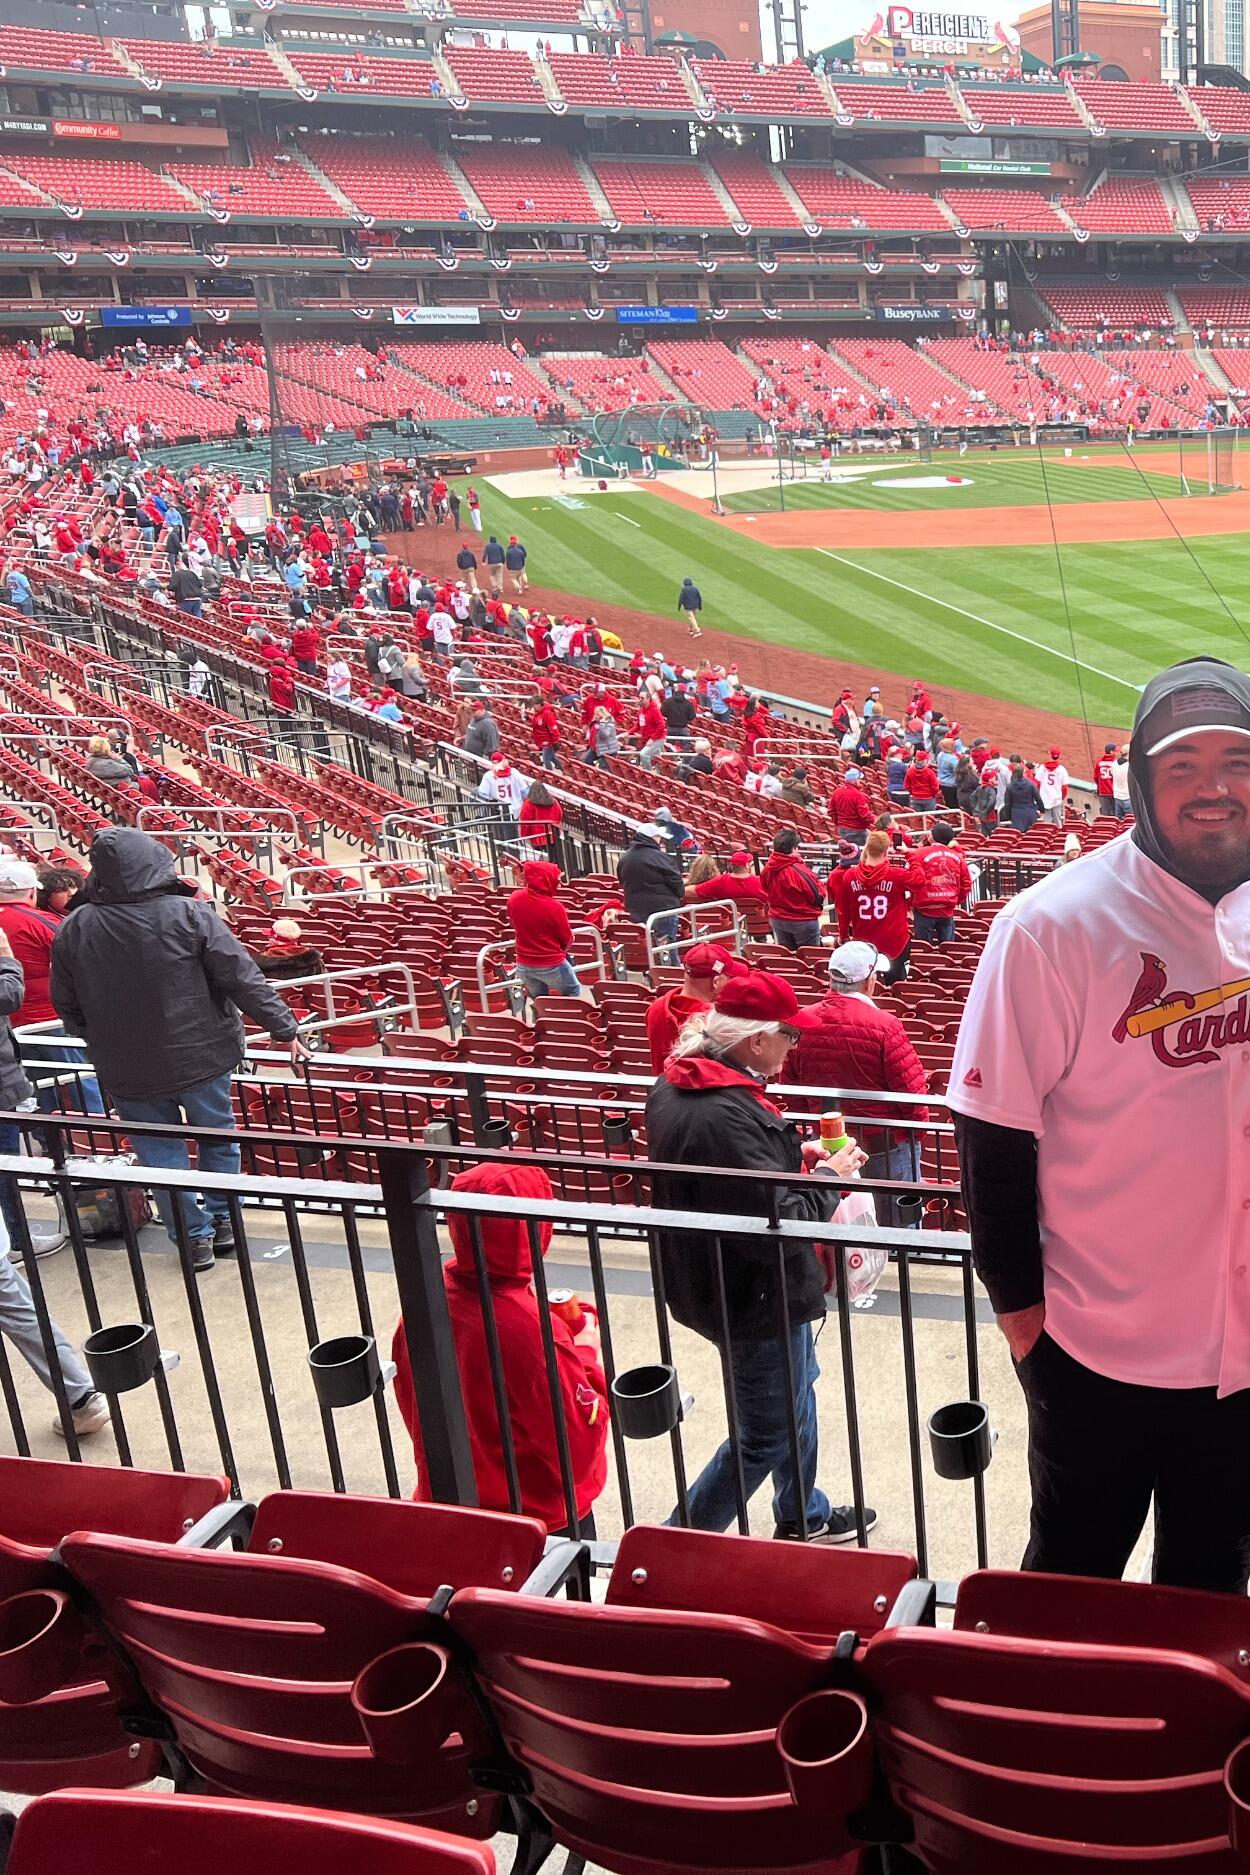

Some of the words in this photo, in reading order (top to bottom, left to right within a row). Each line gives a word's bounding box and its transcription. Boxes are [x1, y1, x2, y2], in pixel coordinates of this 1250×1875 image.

[911, 38, 968, 55] PERCH
[55, 122, 97, 136] Community
[436, 621, 444, 631] 5
[1047, 774, 1056, 786] 5
[497, 784, 512, 799] 51
[857, 895, 888, 920] 28
